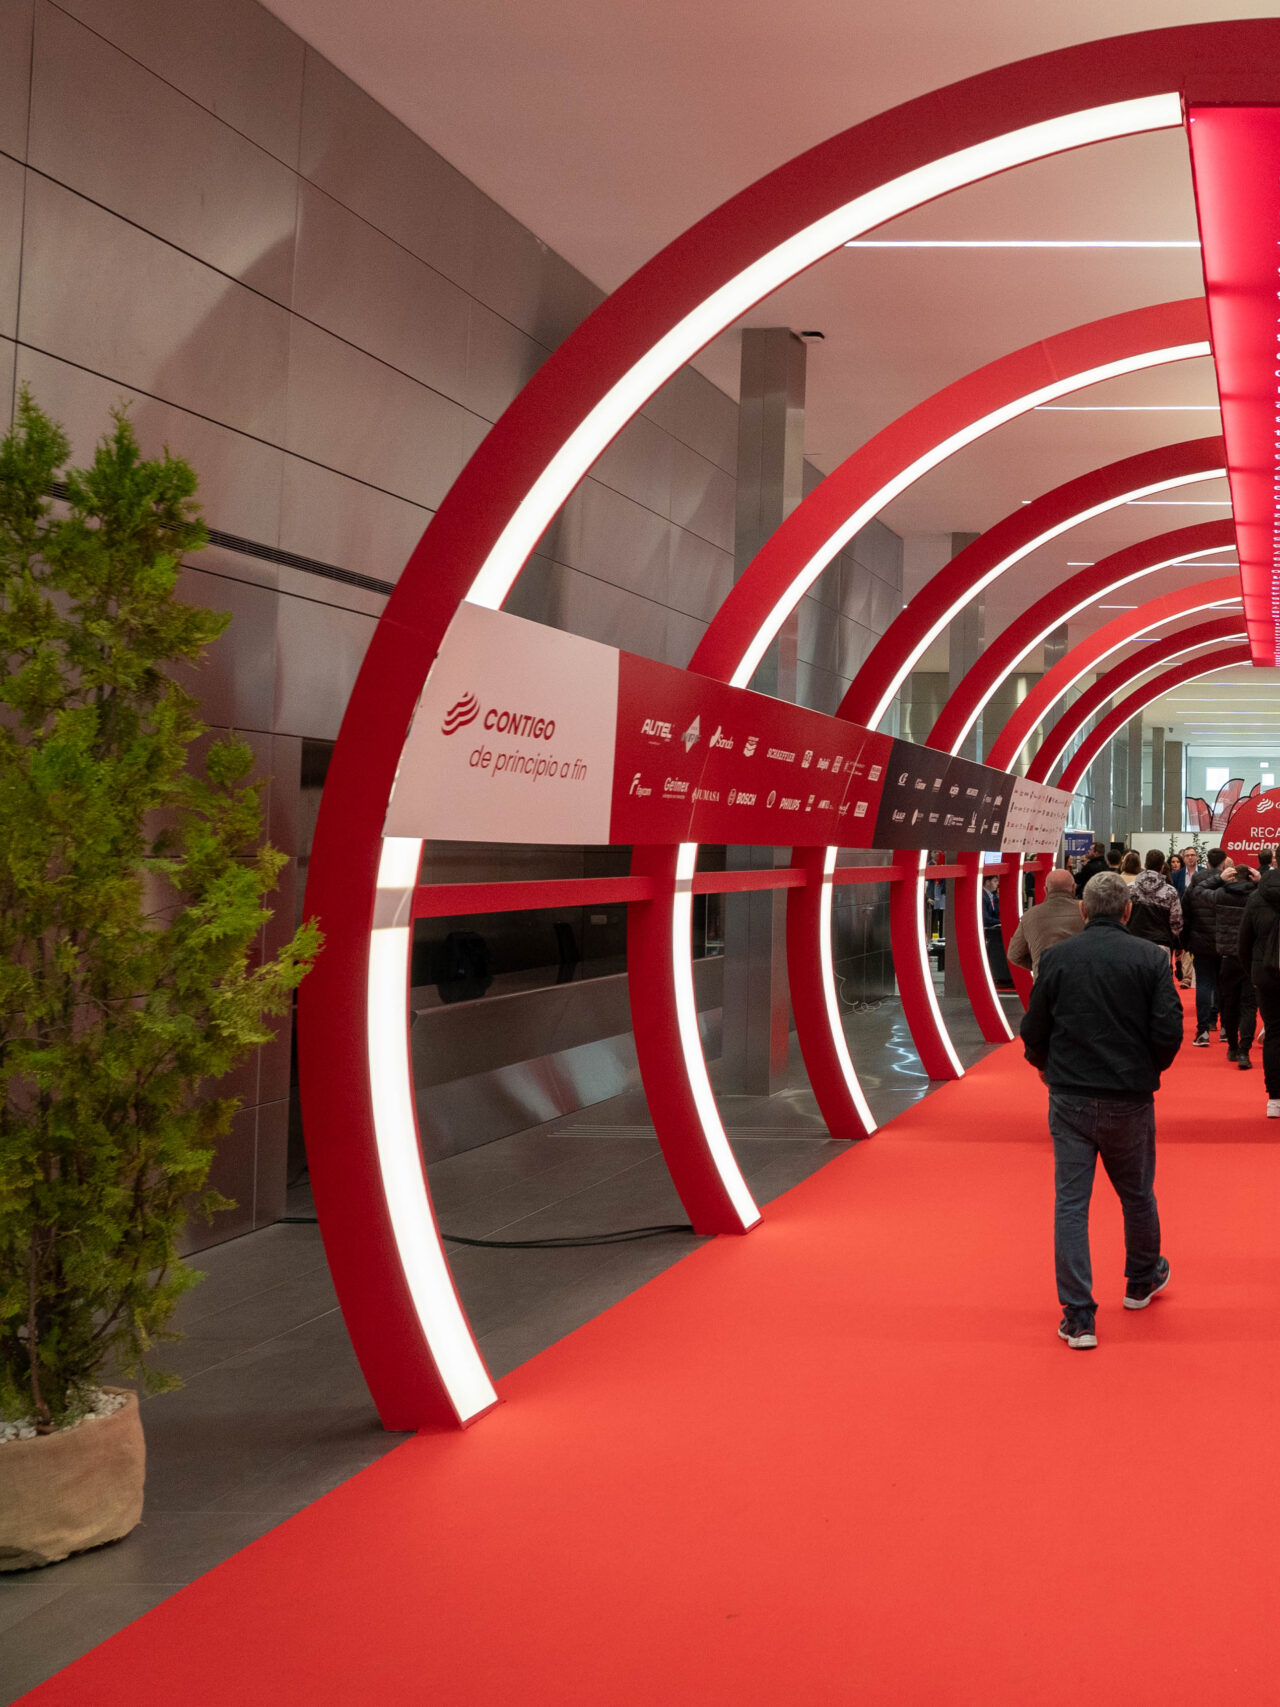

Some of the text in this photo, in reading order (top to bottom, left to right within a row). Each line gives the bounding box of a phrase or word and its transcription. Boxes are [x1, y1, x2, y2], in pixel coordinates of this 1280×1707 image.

[483, 709, 556, 741] CONTIGO
[641, 718, 672, 739] AUTEL
[469, 745, 588, 782] de principio a fin
[736, 792, 757, 806] BOSCH
[1227, 839, 1280, 851] solucion
